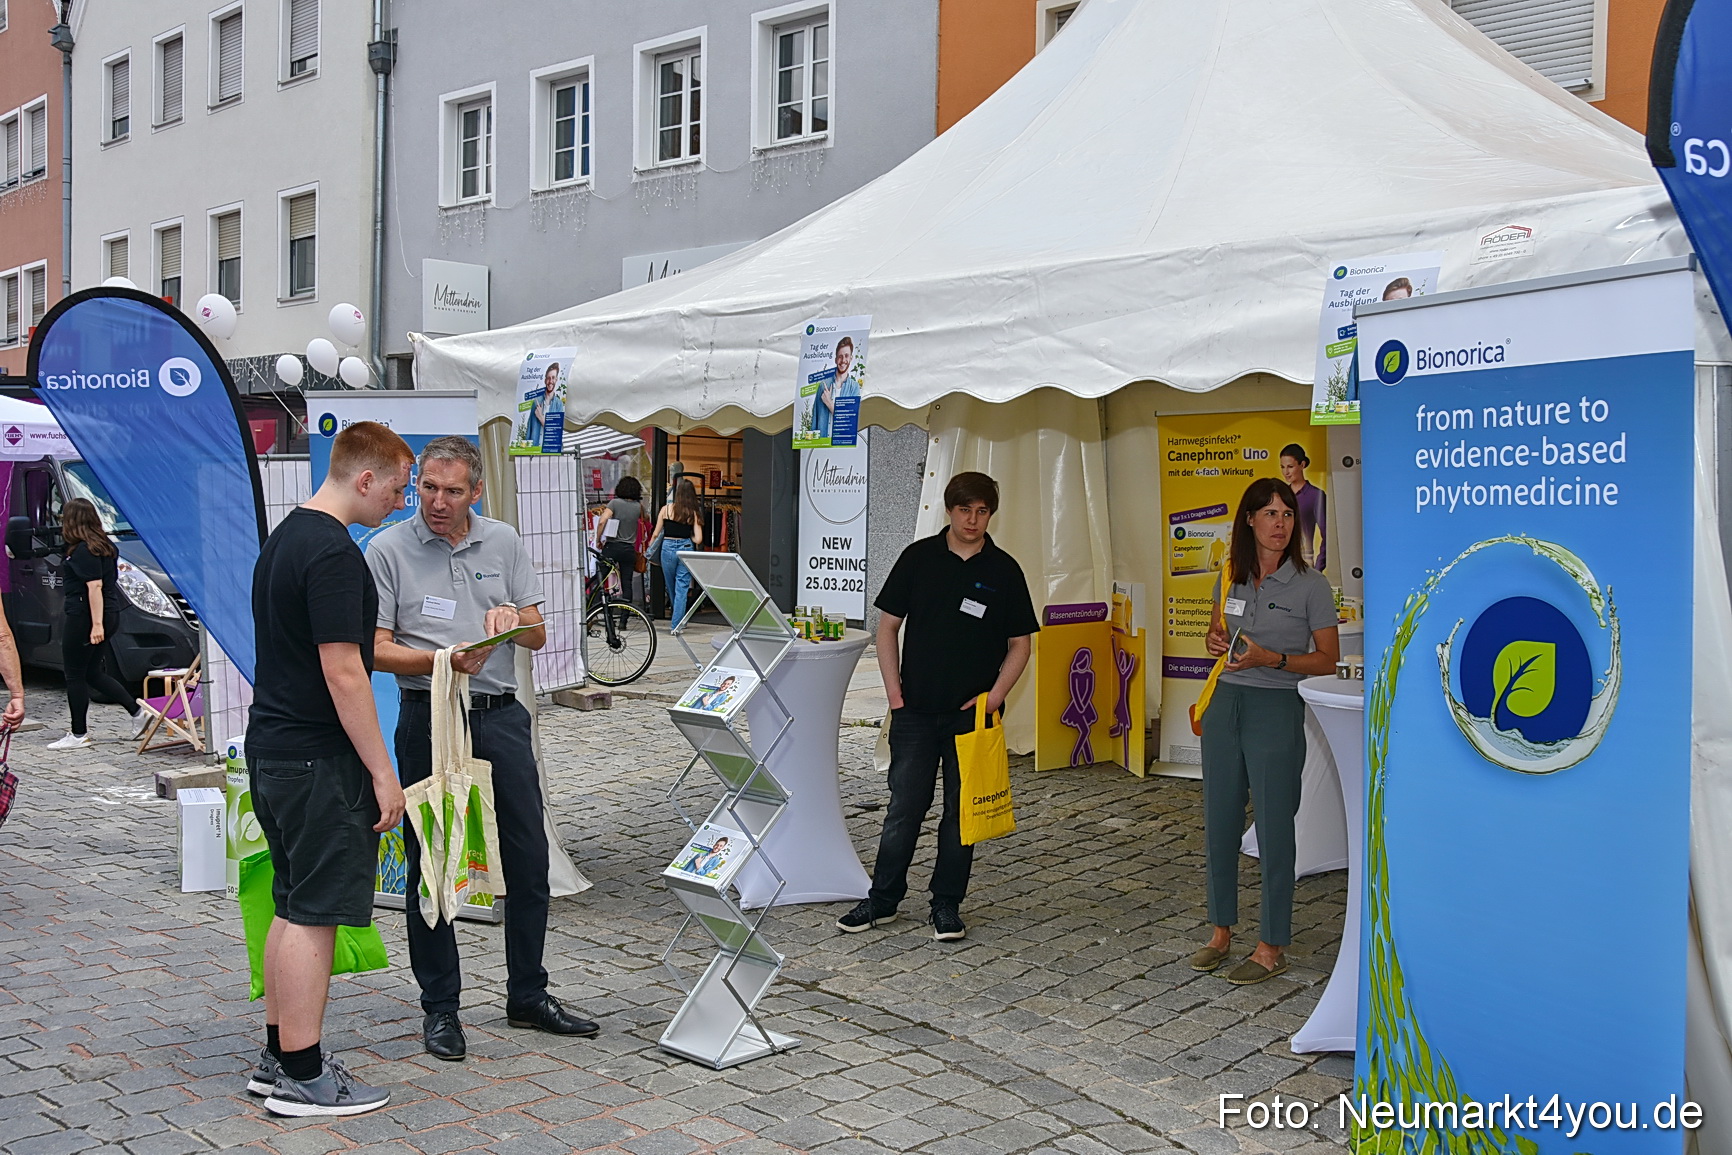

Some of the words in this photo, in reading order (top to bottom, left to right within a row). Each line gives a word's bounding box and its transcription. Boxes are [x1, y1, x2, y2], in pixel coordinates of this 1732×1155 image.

[1484, 232, 1527, 246] RÖDER
[433, 282, 483, 309] Mittendrin
[1339, 288, 1354, 299] Tag
[1355, 287, 1371, 296] der
[810, 344, 819, 352] Tag
[803, 351, 833, 360] Ausbildung
[1416, 403, 1475, 432] from
[1482, 400, 1572, 428] nature
[1579, 396, 1610, 423] to
[1243, 447, 1269, 460] Uno
[1414, 432, 1628, 469] evidence-based
[812, 458, 867, 488] Mittendrin
[1168, 468, 1180, 477] mit
[1181, 468, 1194, 477] der
[1195, 467, 1220, 476] 4-fach
[1221, 467, 1254, 478] Wirkung
[1415, 477, 1620, 513] phytomedicine
[822, 536, 852, 551] NEW
[809, 556, 866, 572] OPENING
[805, 576, 865, 593] 25.03.202
[1168, 663, 1179, 672] Die
[1341, 668, 1347, 679] 1
[1356, 668, 1362, 679] 2
[227, 884, 235, 894] 50
